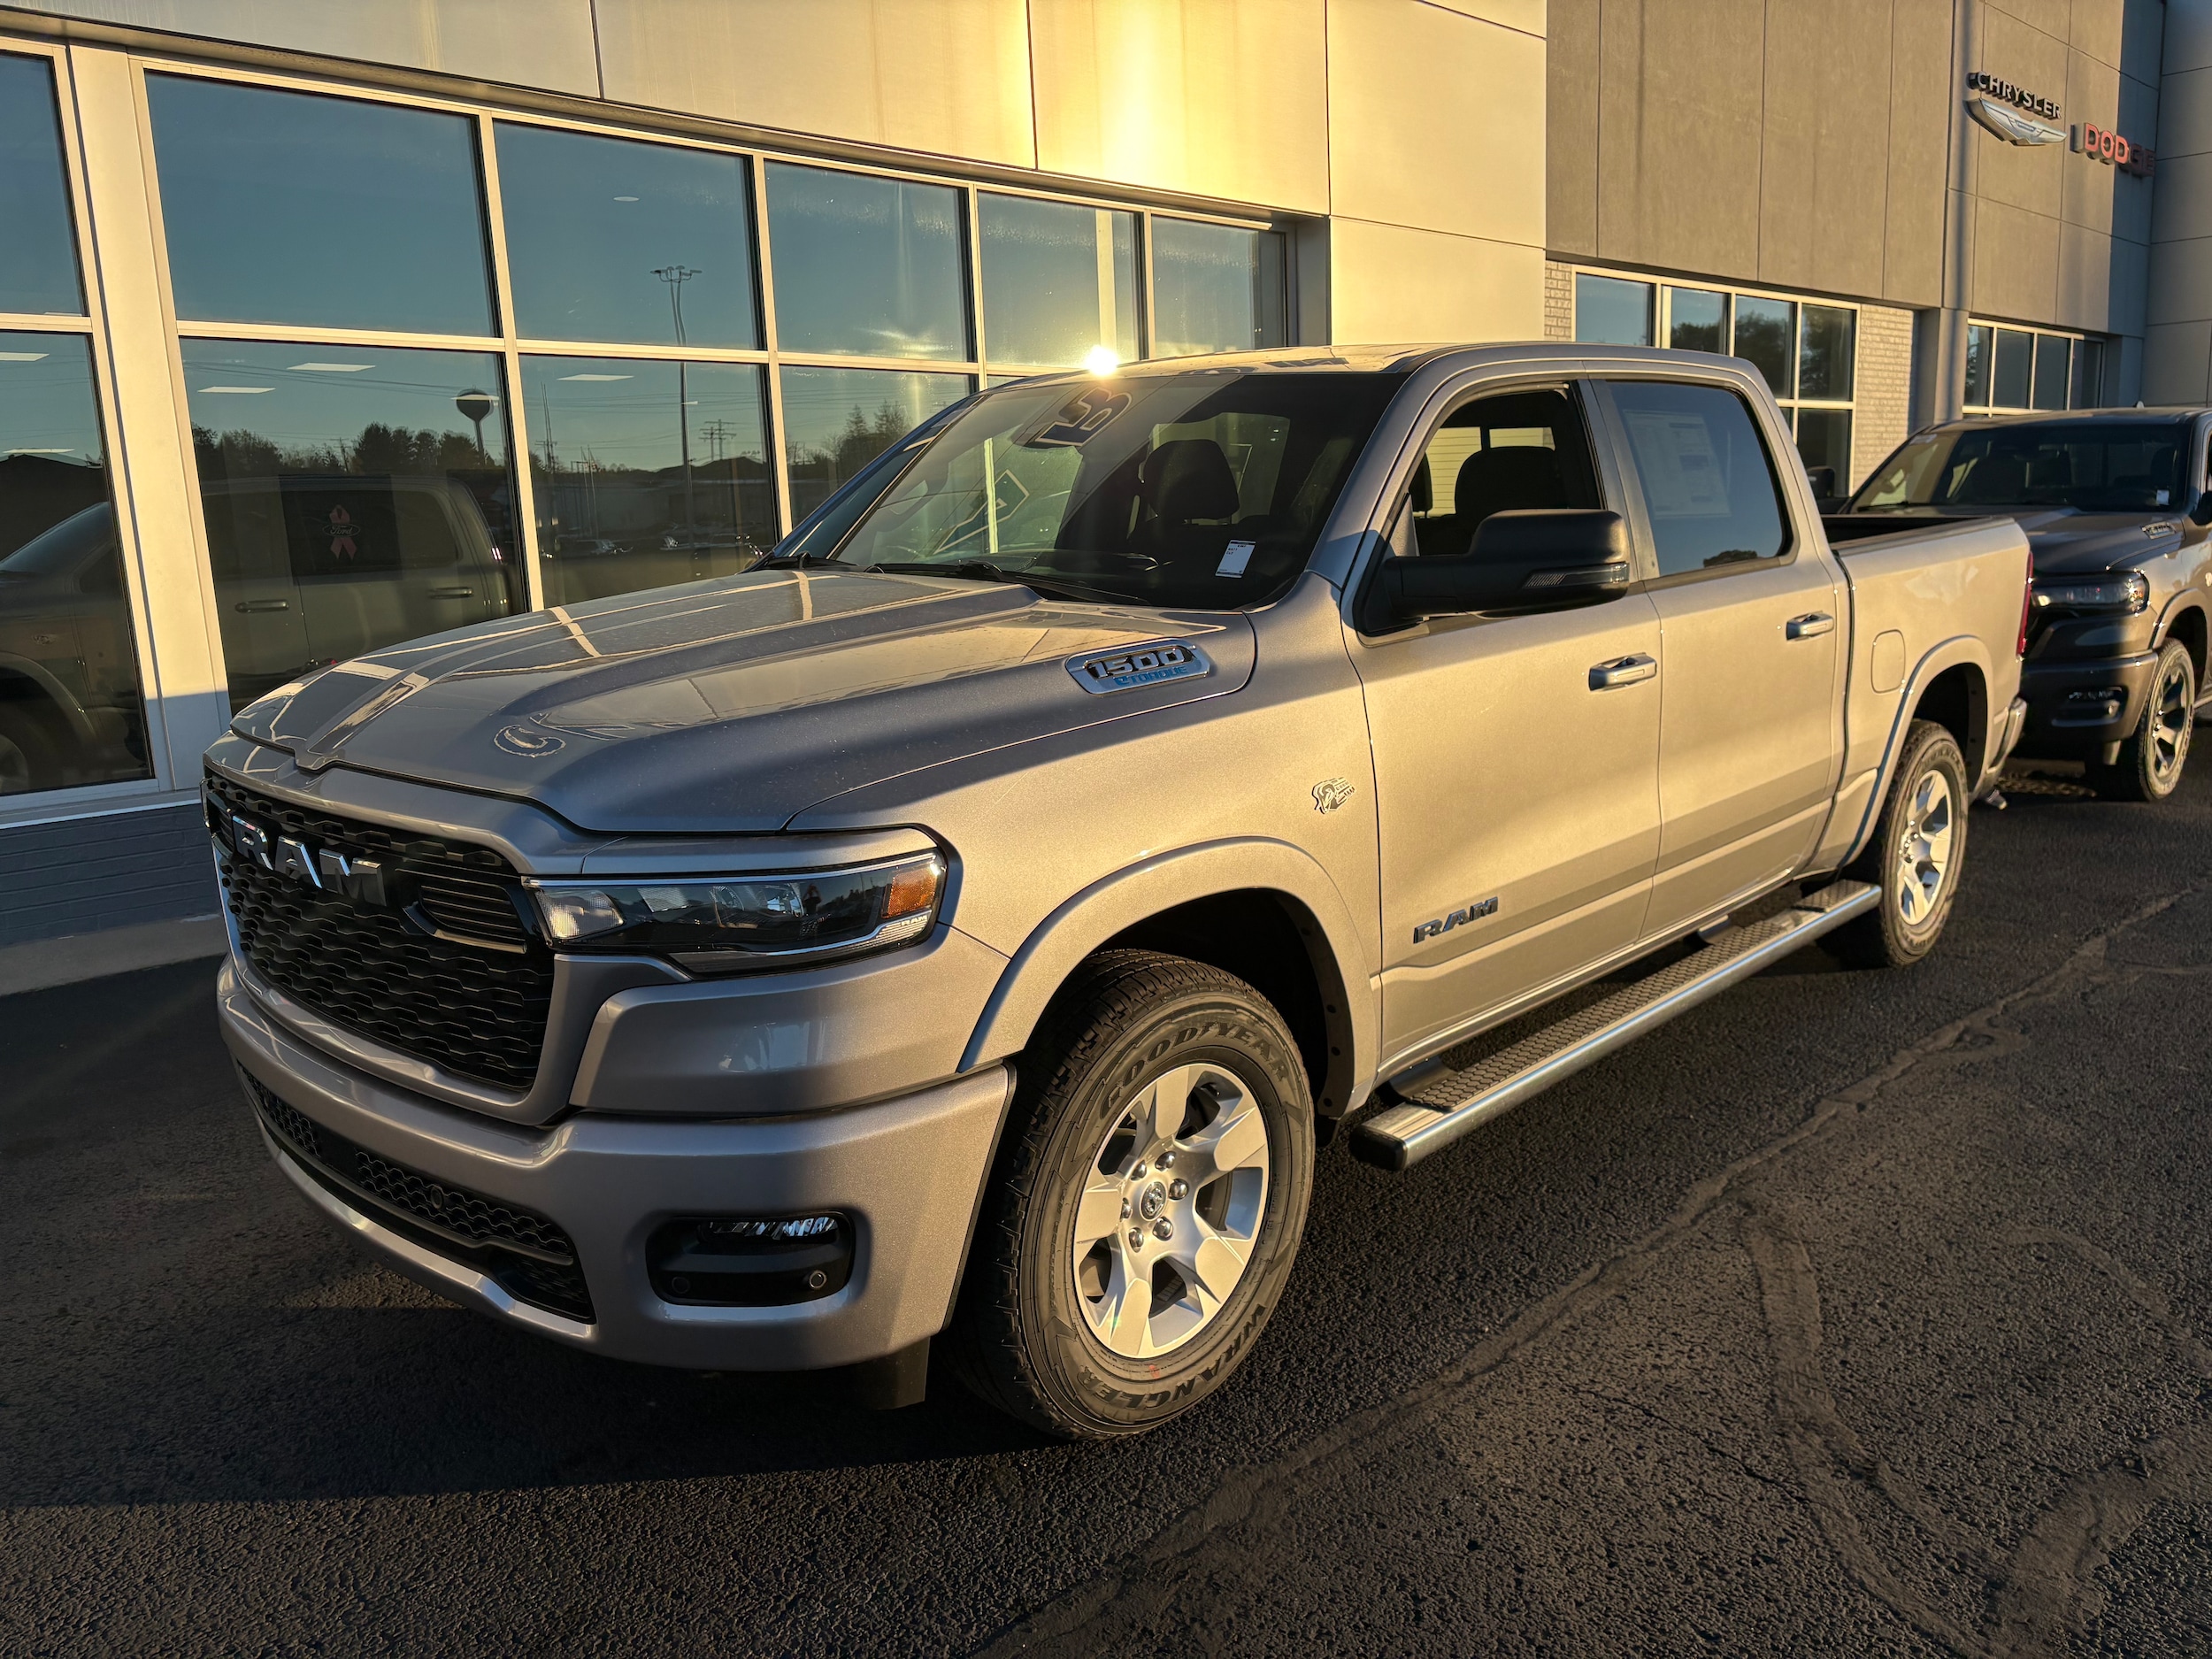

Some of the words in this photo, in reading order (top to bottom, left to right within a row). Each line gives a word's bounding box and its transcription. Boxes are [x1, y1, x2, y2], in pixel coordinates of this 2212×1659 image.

[1976, 70, 2063, 120] CHRYSLER
[2084, 122, 2156, 177] DODGE
[1084, 647, 1189, 680] 1500
[232, 814, 387, 908] RAM
[901, 914, 928, 926] RAM
[1413, 895, 1499, 945] RAM
[1100, 1021, 1289, 1120] GOODYEAR
[1076, 1302, 1267, 1409] WRANGLER
